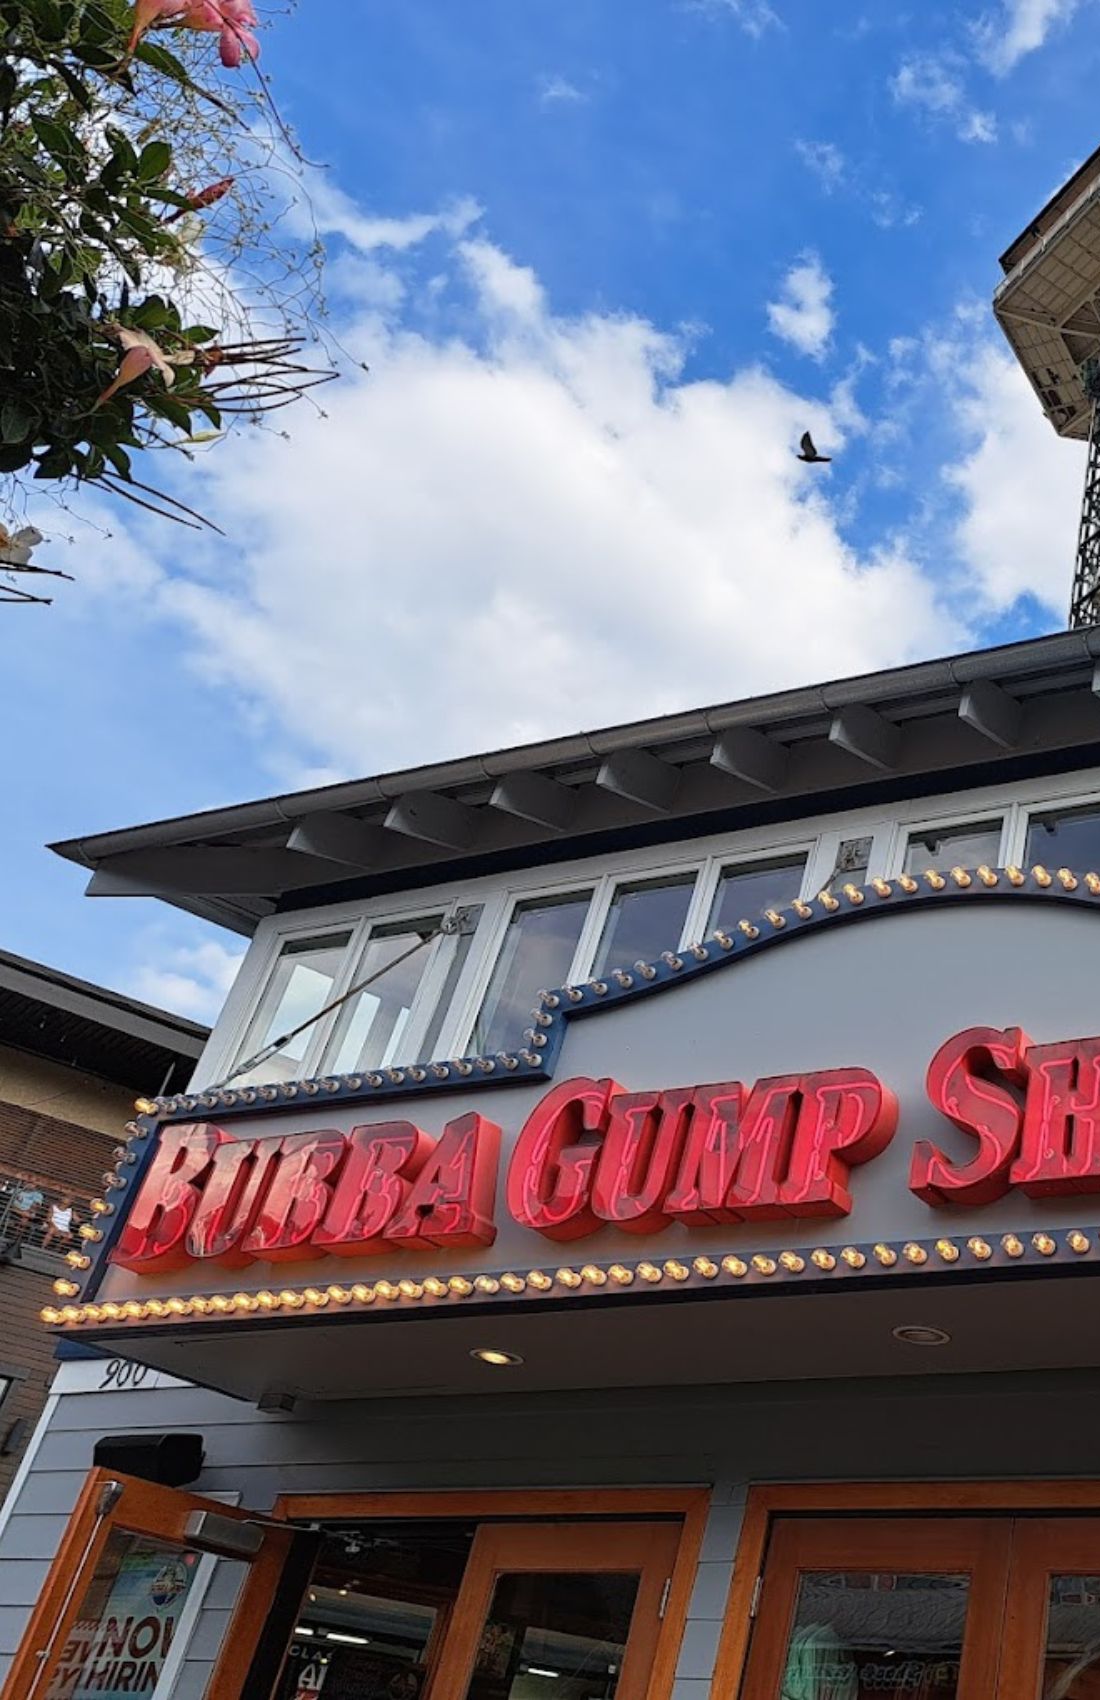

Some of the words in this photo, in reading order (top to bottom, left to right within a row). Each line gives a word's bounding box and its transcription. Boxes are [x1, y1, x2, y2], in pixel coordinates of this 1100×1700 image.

[110, 1111, 501, 1275] BUBBA
[506, 1067, 899, 1240] GUMP
[98, 1359, 148, 1389] 900
